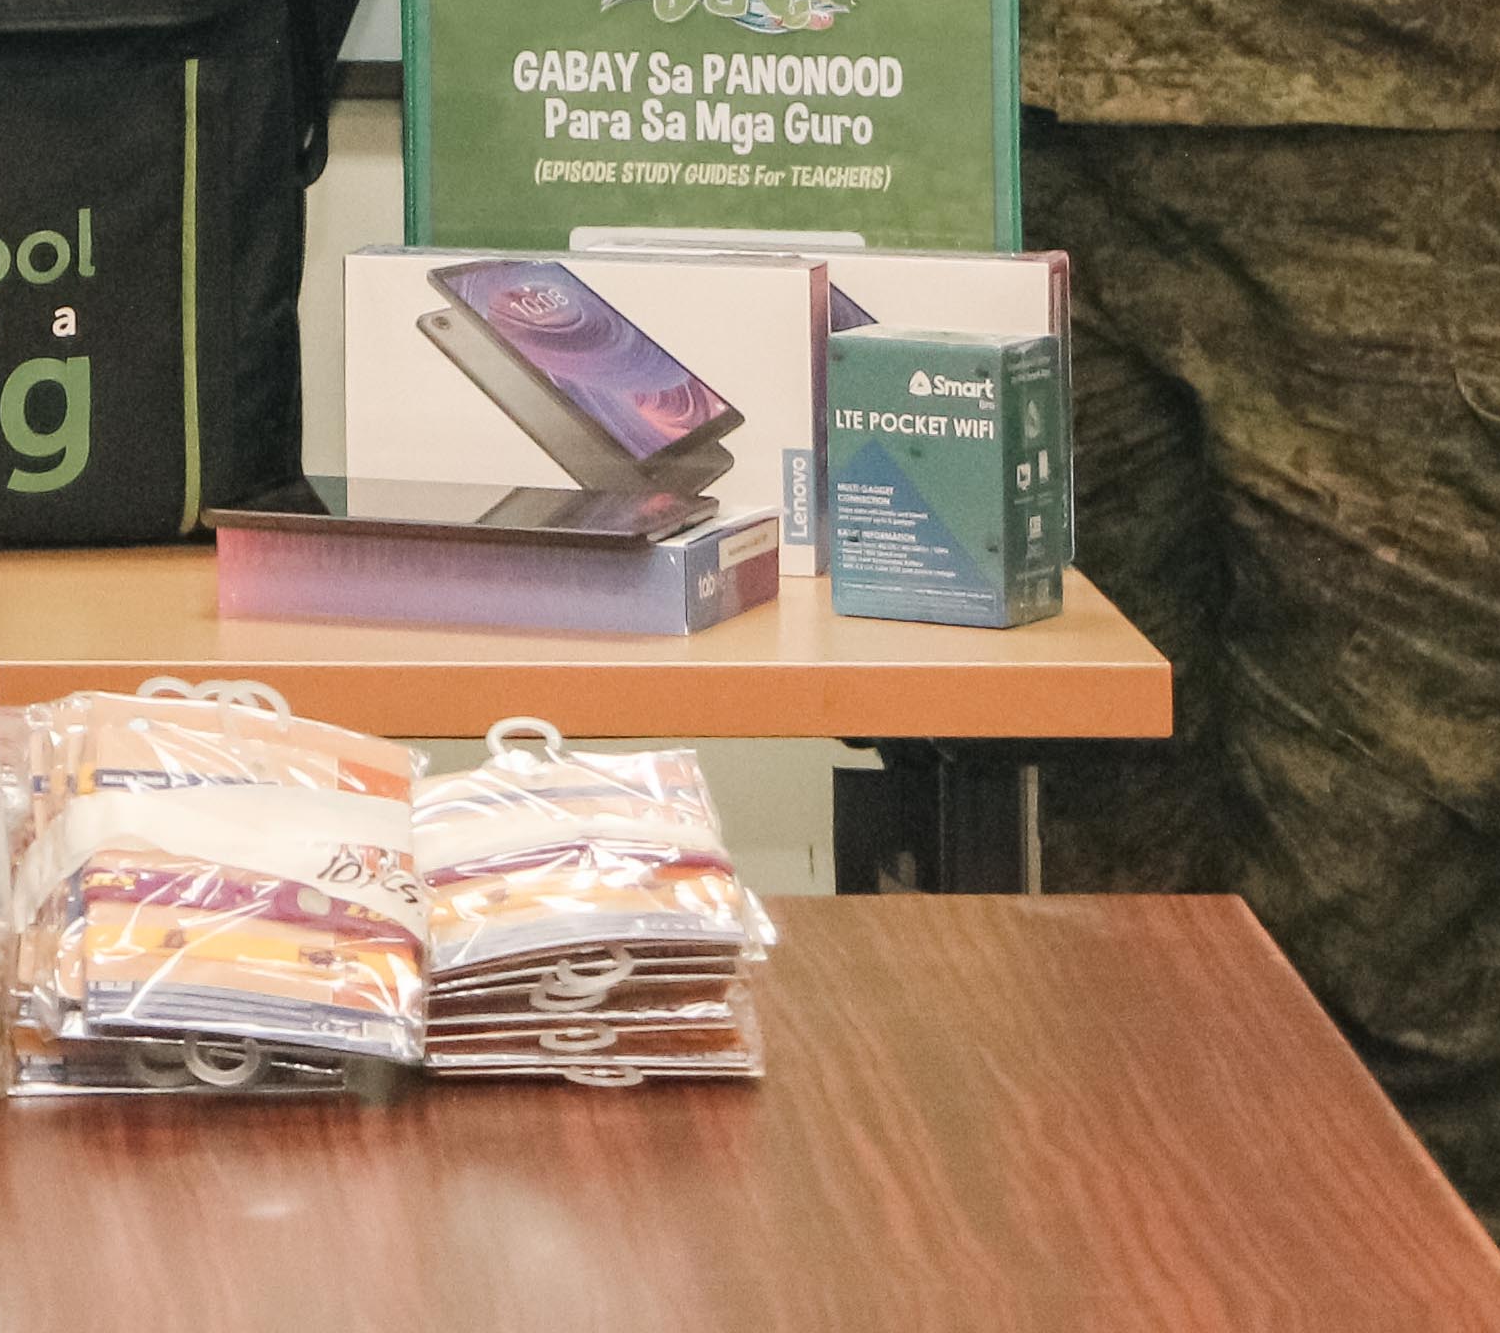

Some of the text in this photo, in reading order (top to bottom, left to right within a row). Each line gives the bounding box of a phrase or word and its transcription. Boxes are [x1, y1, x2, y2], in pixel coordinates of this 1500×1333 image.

[513, 50, 904, 98] GABAY Sa PANONOOD
[544, 97, 873, 155] Para Sa Mga Guro
[534, 158, 617, 185] (EPISODE
[621, 161, 682, 185] STUDY
[684, 163, 750, 186] GUIDES
[791, 165, 893, 192] TEACHERS)
[52, 305, 78, 338] a
[933, 375, 995, 400] Smart
[835, 409, 995, 440] LTE POCKET WIFI
[791, 456, 808, 538] Lenovo
